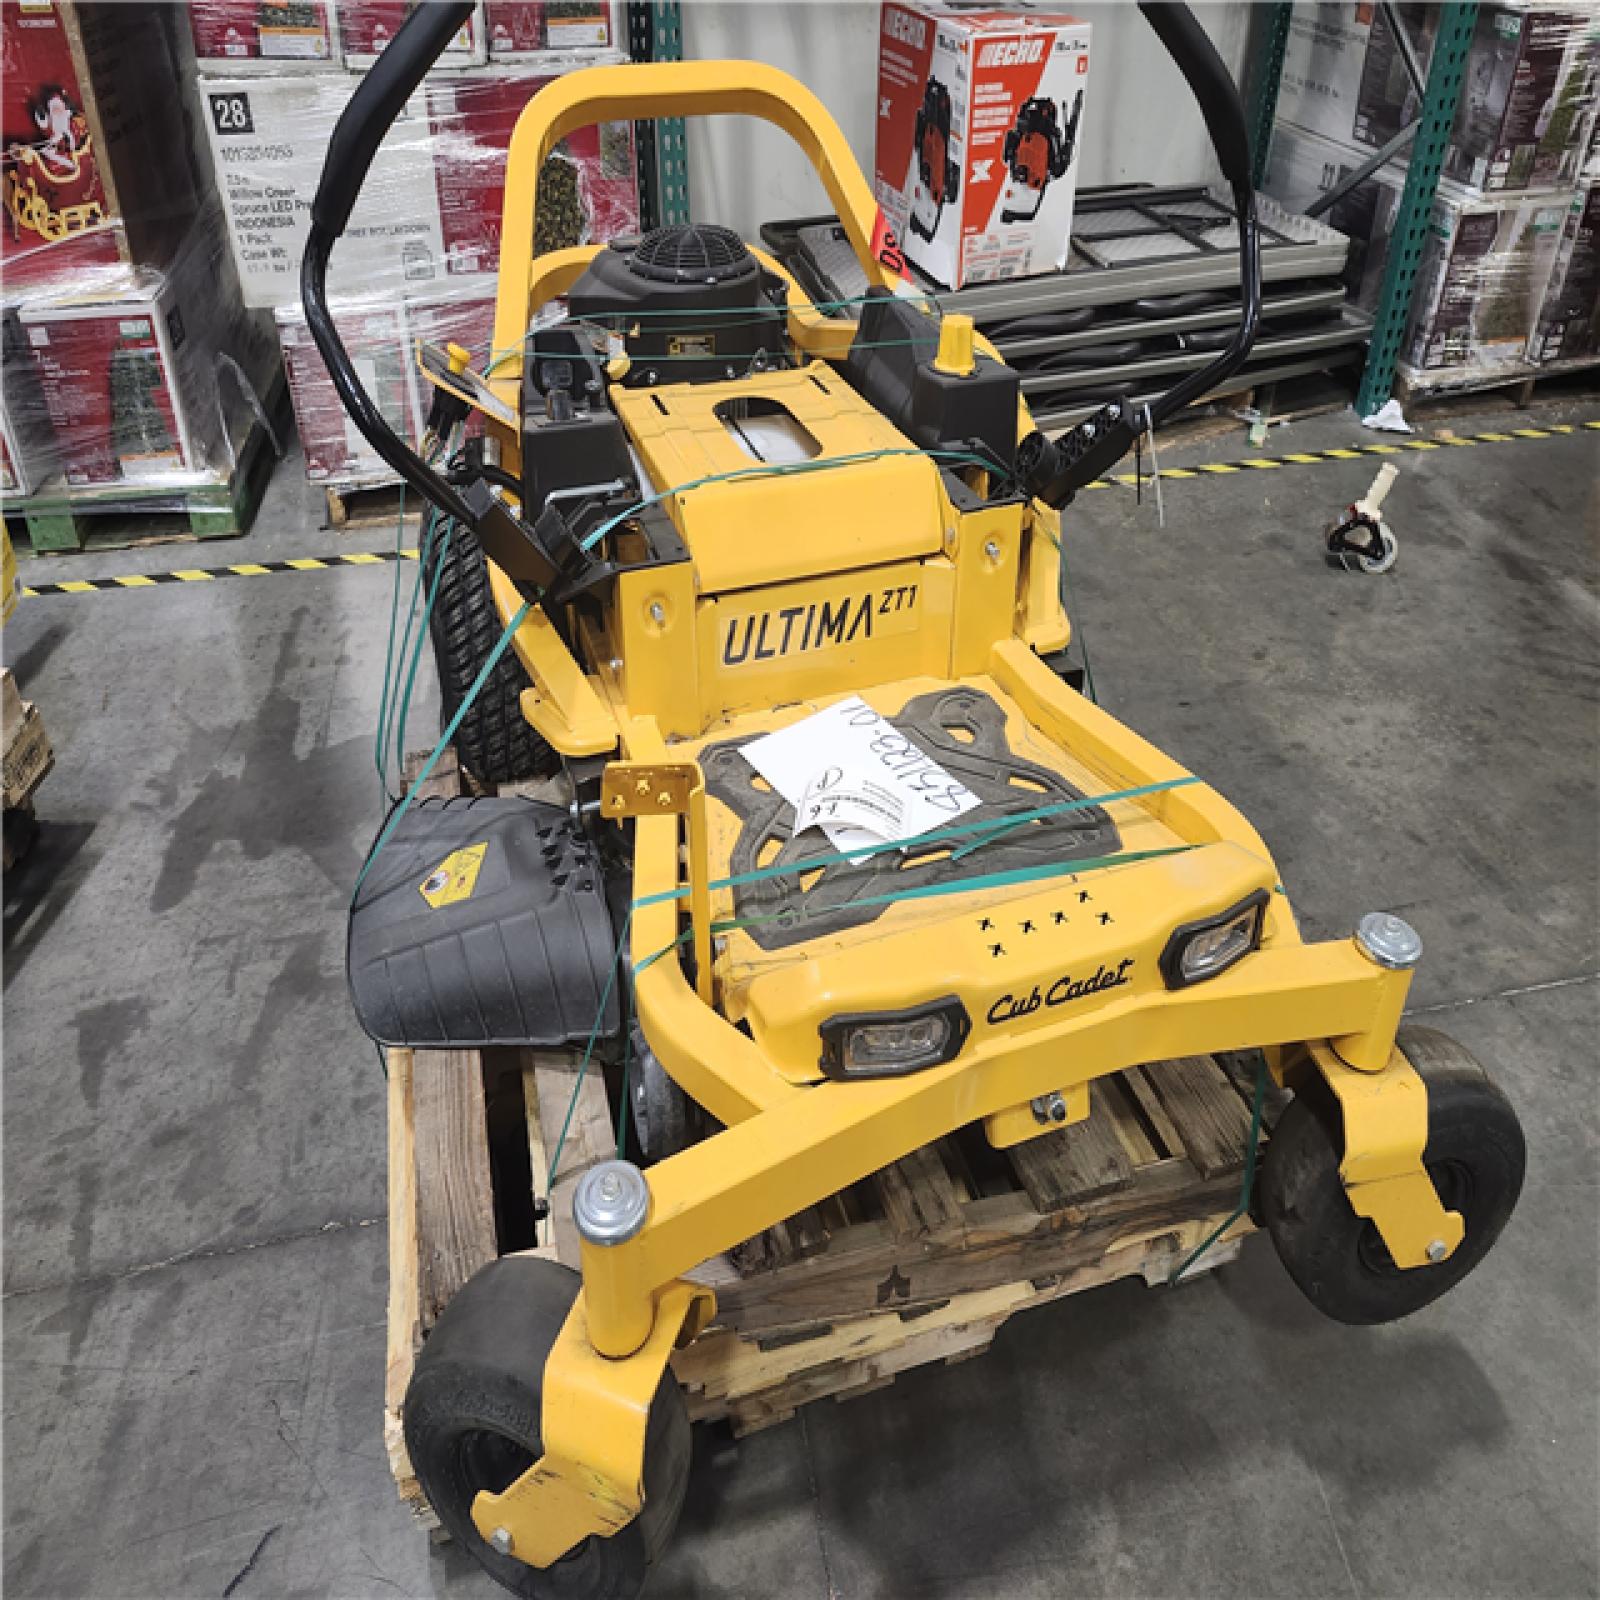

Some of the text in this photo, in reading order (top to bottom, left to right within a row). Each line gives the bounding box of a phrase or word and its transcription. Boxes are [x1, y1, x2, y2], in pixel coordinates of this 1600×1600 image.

[984, 38, 1046, 67] ECHO
[214, 99, 247, 129] 28
[235, 215, 296, 231] INDONESIA
[723, 584, 918, 666] ULTIMA ZT1
[987, 957, 1135, 1026] Cub Cadet
